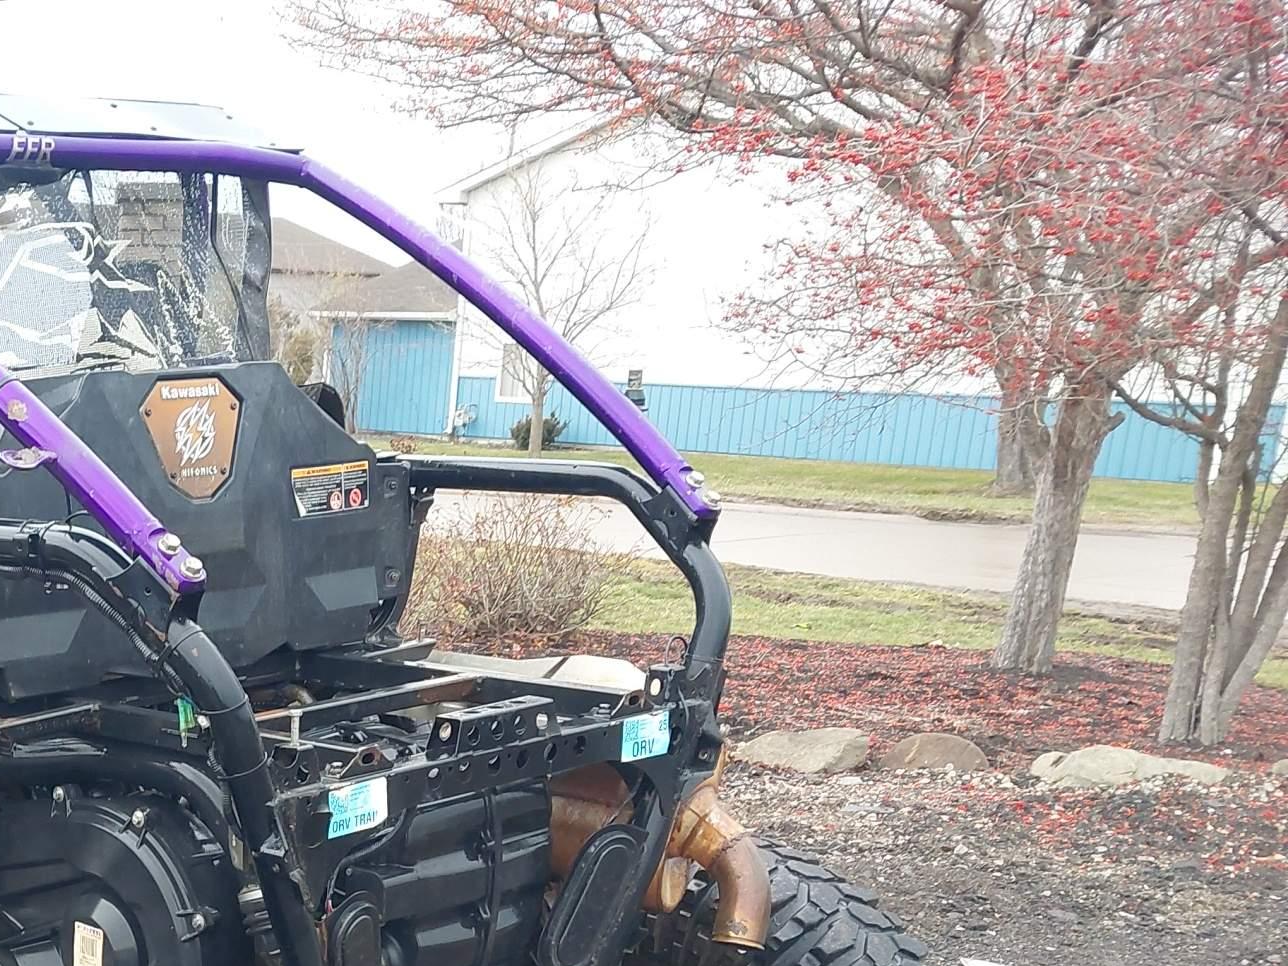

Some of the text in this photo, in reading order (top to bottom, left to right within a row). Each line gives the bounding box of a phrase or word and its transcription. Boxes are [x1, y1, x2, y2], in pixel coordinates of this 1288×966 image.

[160, 383, 220, 400] Kawasaki
[632, 738, 655, 758] ORV
[332, 816, 351, 833] ORV
